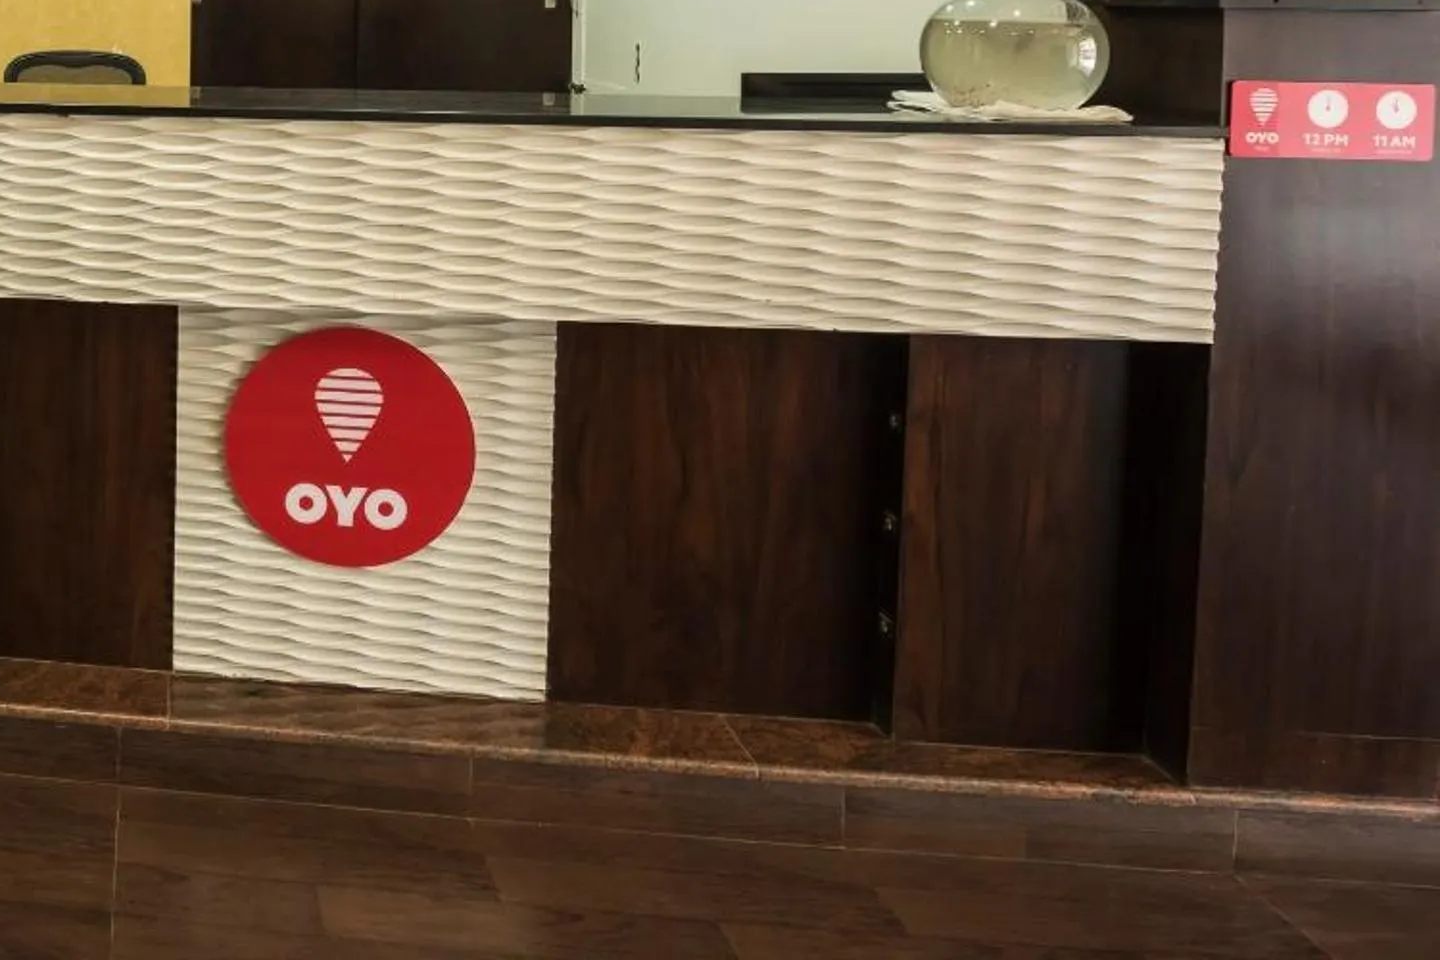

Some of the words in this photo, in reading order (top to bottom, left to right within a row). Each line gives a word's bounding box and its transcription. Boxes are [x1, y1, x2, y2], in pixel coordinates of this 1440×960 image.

[1246, 132, 1279, 144] OYO
[1304, 133, 1320, 145] 12
[1324, 134, 1349, 147] PM
[1373, 135, 1387, 147] 11
[1390, 135, 1416, 148] AM
[285, 482, 408, 530] OYO
